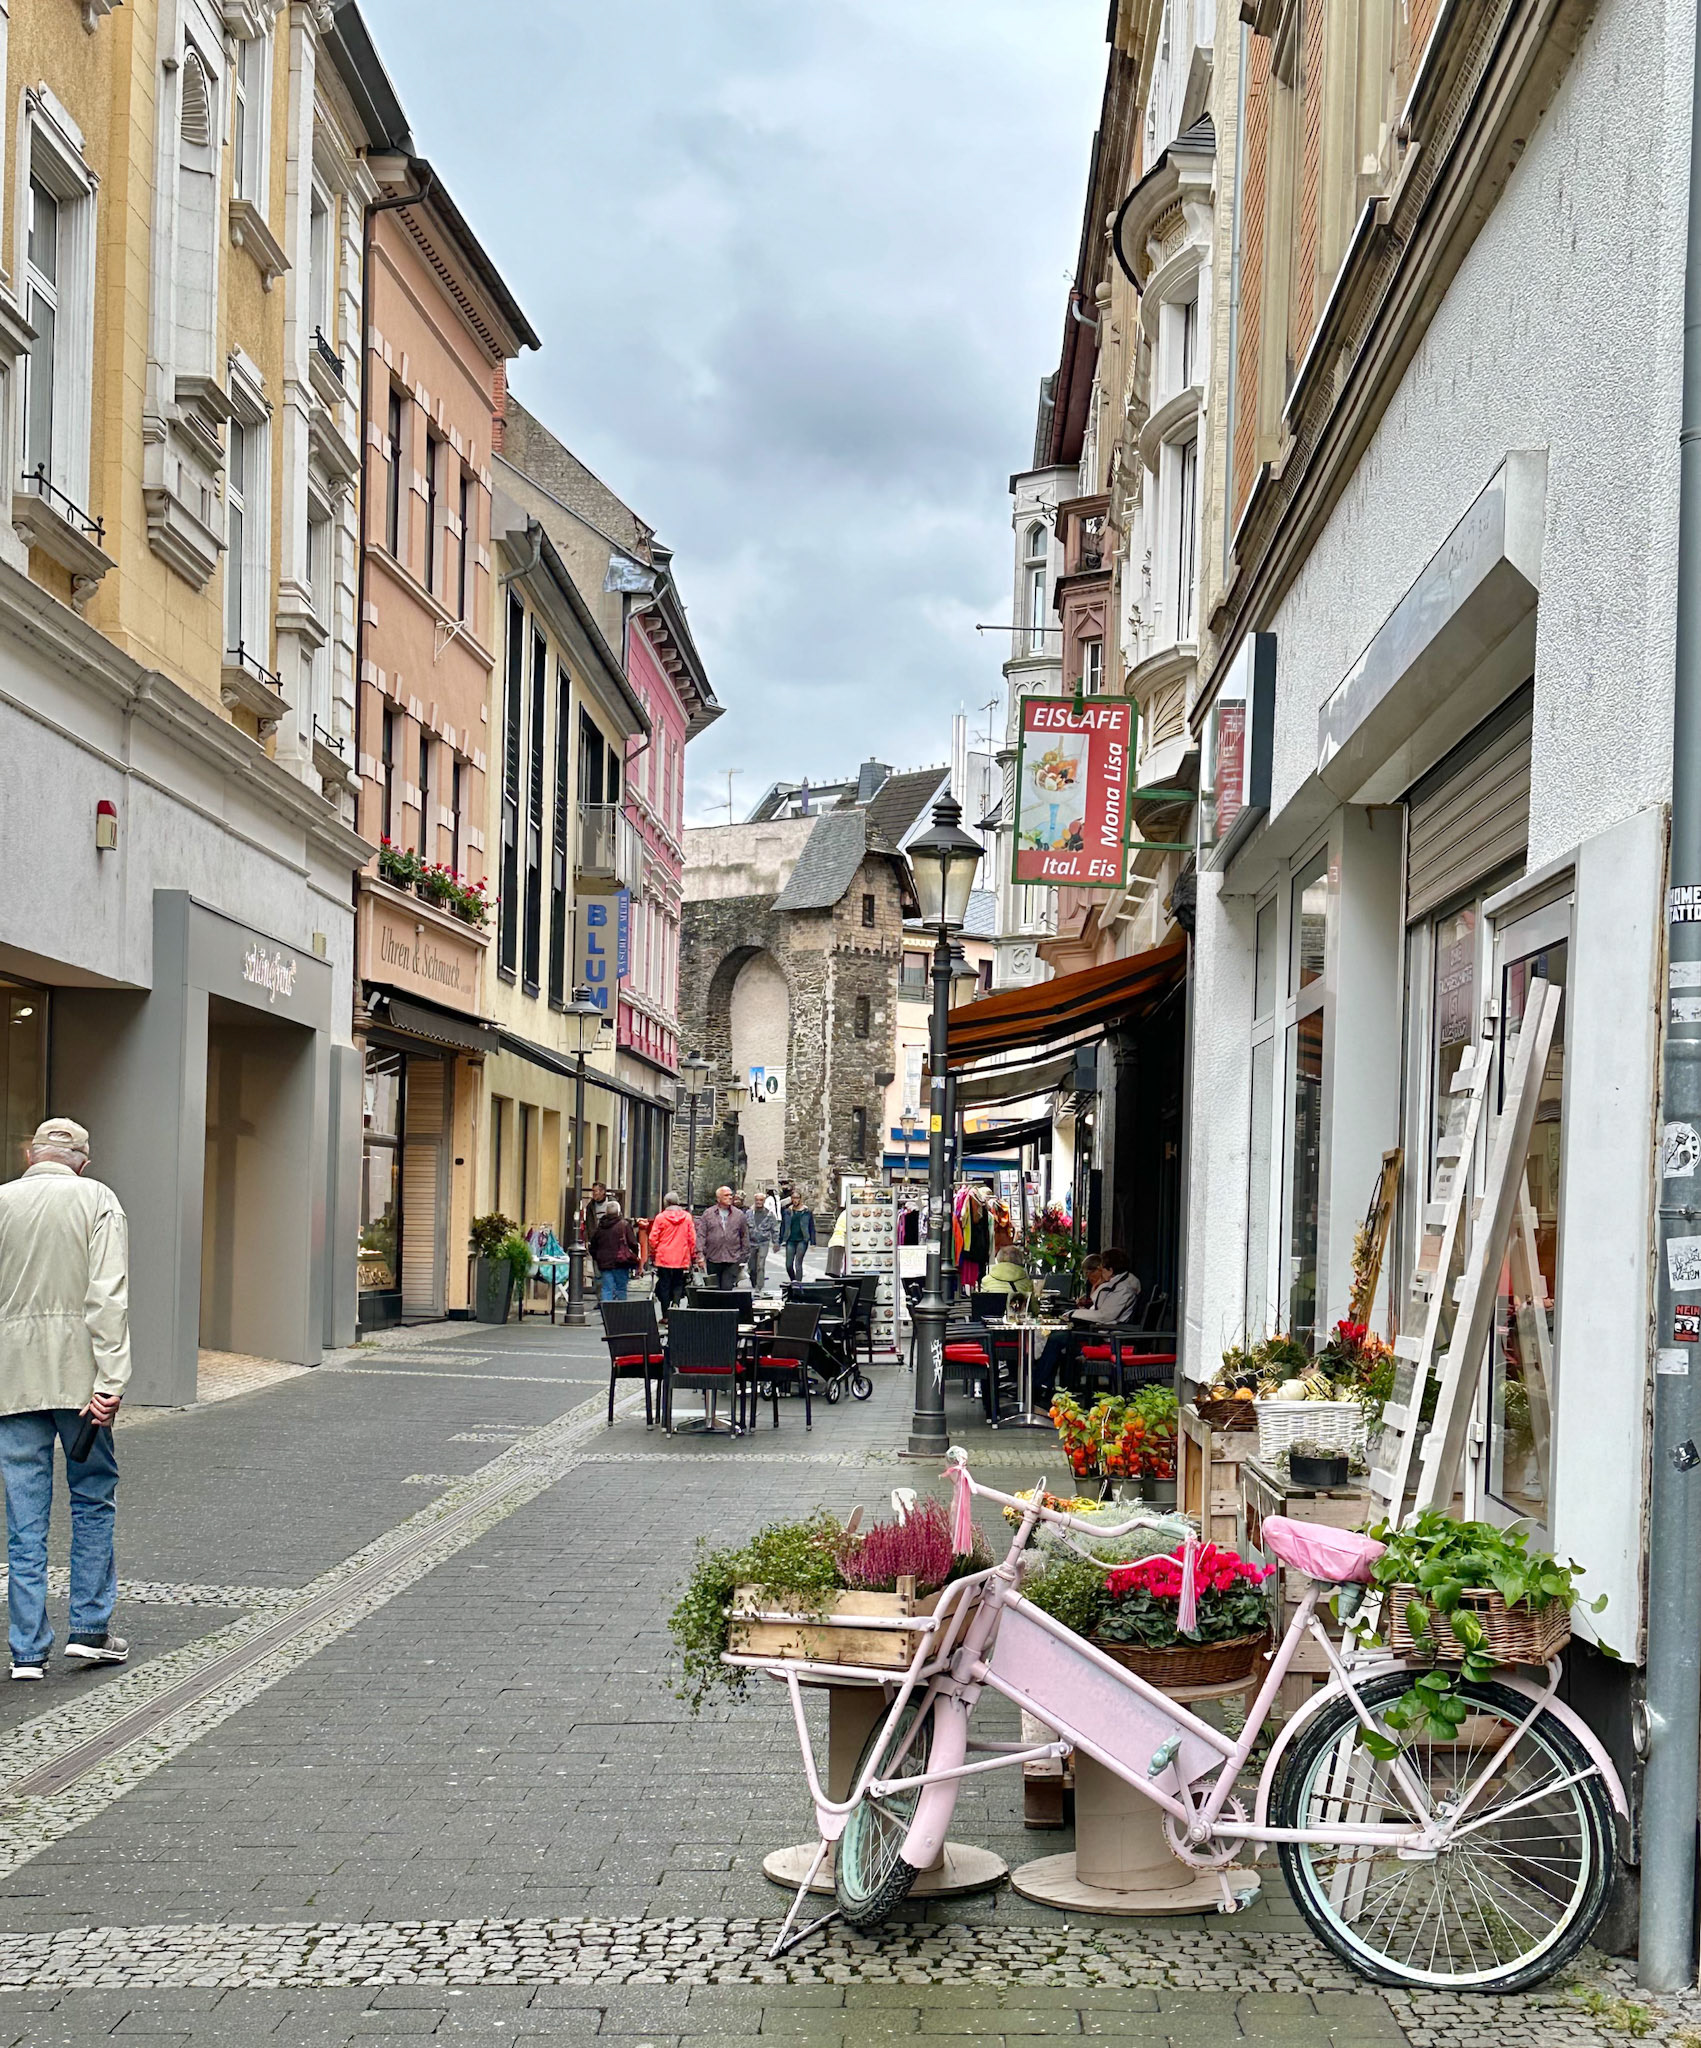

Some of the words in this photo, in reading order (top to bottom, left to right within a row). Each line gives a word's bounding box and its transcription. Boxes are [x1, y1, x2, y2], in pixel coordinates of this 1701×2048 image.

[1033, 708, 1124, 729] EISCAFE
[1103, 742, 1123, 783] Lisa
[1101, 787, 1121, 847] Mona
[1042, 857, 1081, 876] Ital.
[1088, 859, 1117, 877] Eis
[381, 925, 410, 971] Uhren
[412, 953, 420, 975] &
[421, 943, 460, 989] Schmuck
[586, 904, 608, 1009] BLUM
[1676, 1305, 1699, 1315] NEIN
